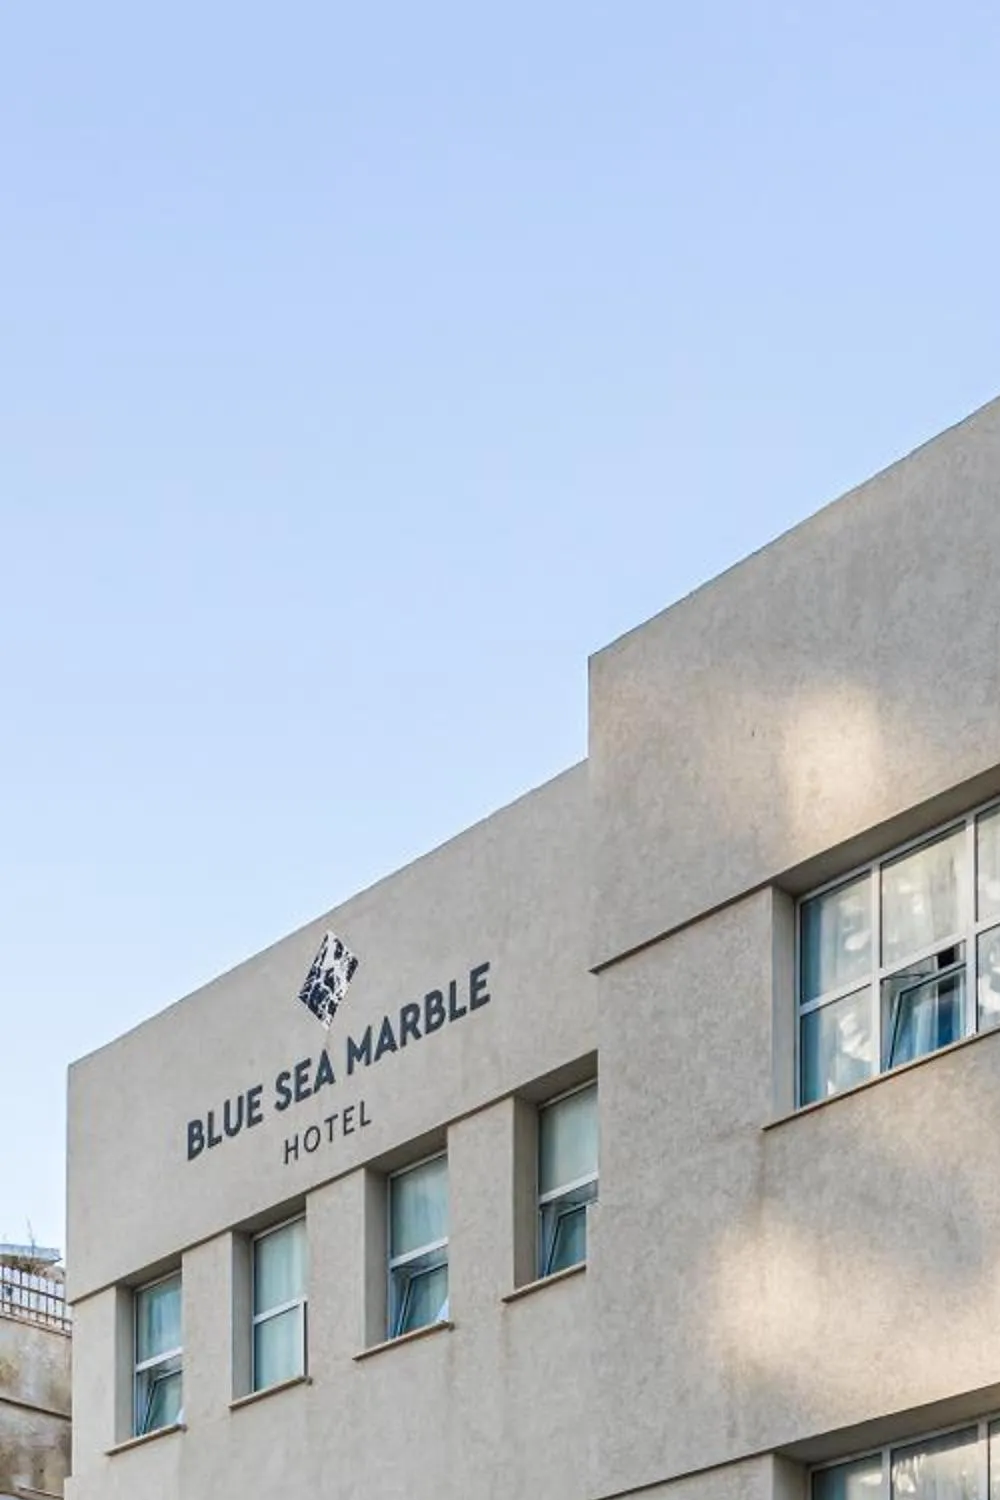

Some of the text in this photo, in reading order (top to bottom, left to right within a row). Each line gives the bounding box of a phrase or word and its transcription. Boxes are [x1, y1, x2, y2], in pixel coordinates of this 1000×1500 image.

[187, 962, 491, 1160] BLUE SEA MARBLE
[284, 1101, 371, 1164] HOTEL
